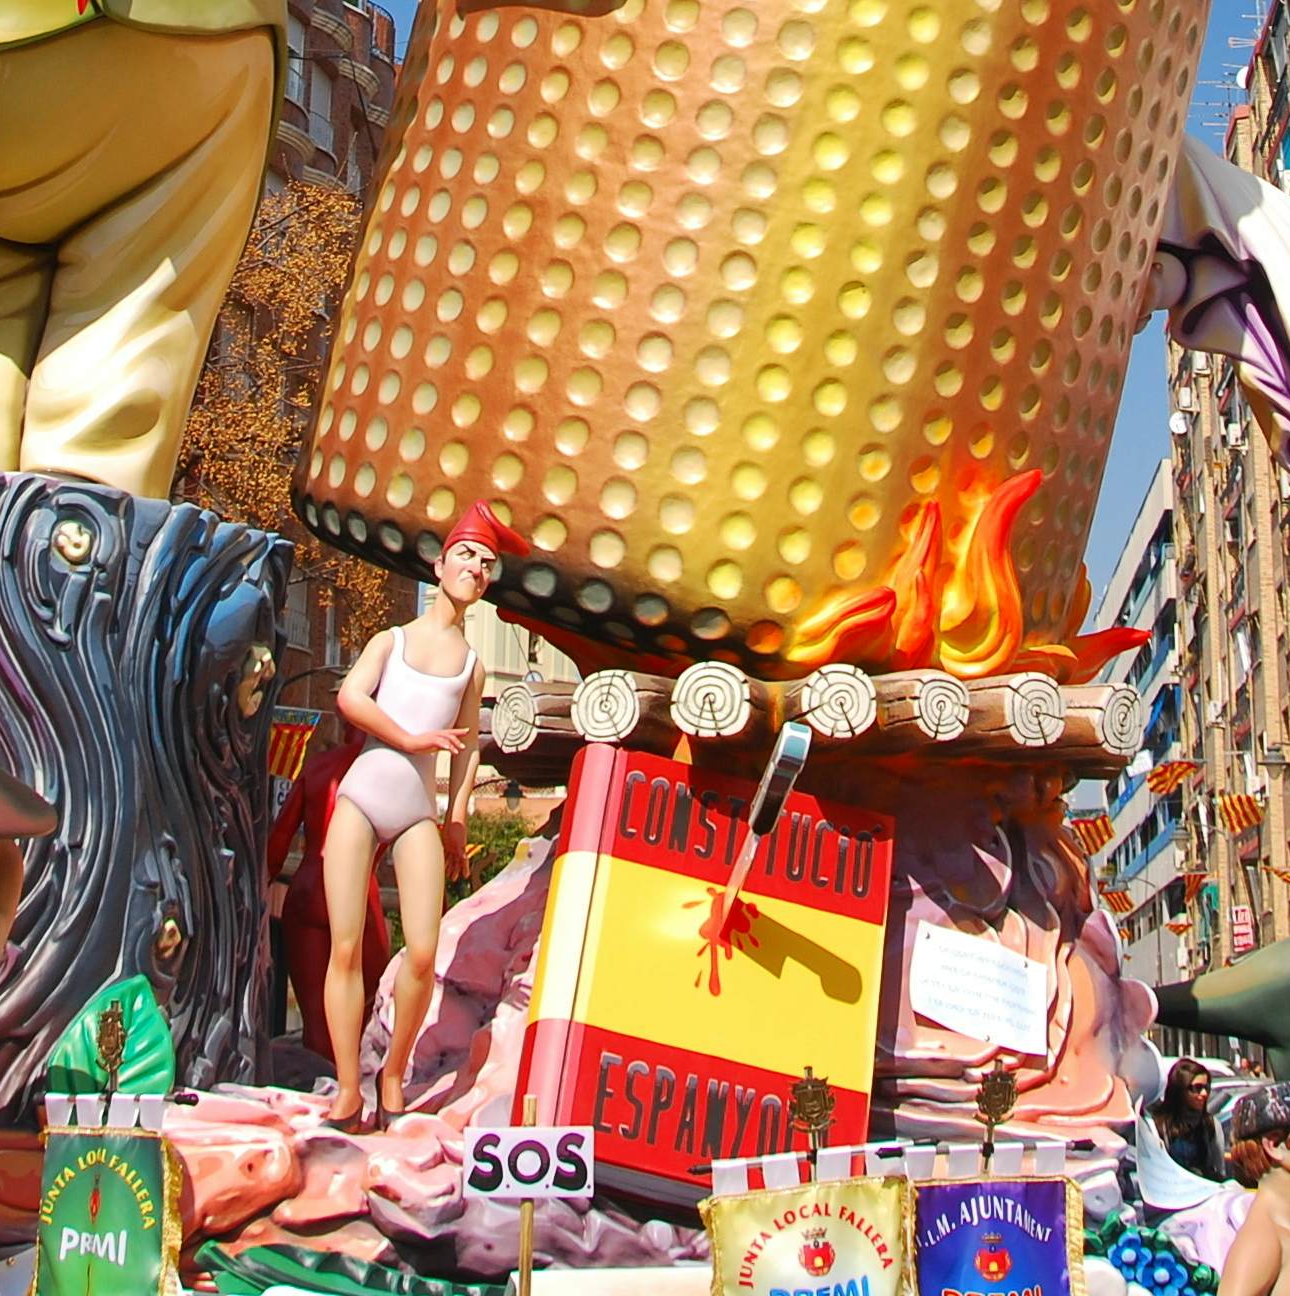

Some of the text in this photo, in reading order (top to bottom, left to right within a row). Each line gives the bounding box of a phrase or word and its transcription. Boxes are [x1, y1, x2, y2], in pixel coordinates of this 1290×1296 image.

[40, 1166, 76, 1225] JUNTA
[108, 1154, 157, 1230] FALLERA
[960, 1195, 1053, 1243] AJUNTAMENT
[738, 1202, 894, 1289] JUNTA LOCAL FALLERA
